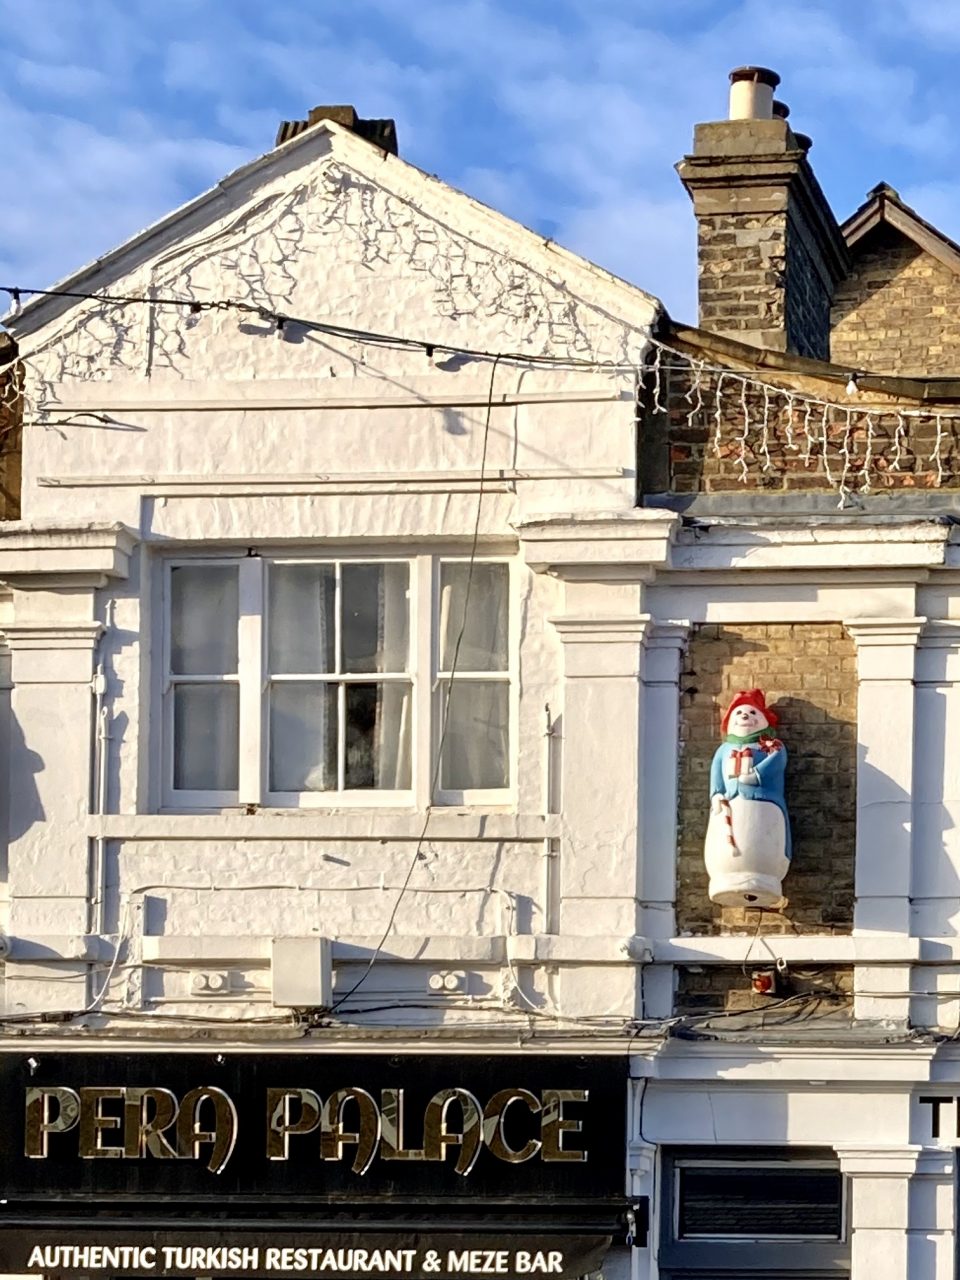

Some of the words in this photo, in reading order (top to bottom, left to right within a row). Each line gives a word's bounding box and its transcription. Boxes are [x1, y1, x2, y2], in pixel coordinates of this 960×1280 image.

[24, 1086, 238, 1174] PERA
[266, 1087, 589, 1176] PALACE
[27, 1245, 156, 1269] AUTHENTIC
[162, 1246, 259, 1270] TURKISH
[265, 1247, 417, 1272] RESTAURANT
[422, 1250, 441, 1273] &
[447, 1250, 509, 1273] MEZE
[515, 1251, 563, 1273] BAR
